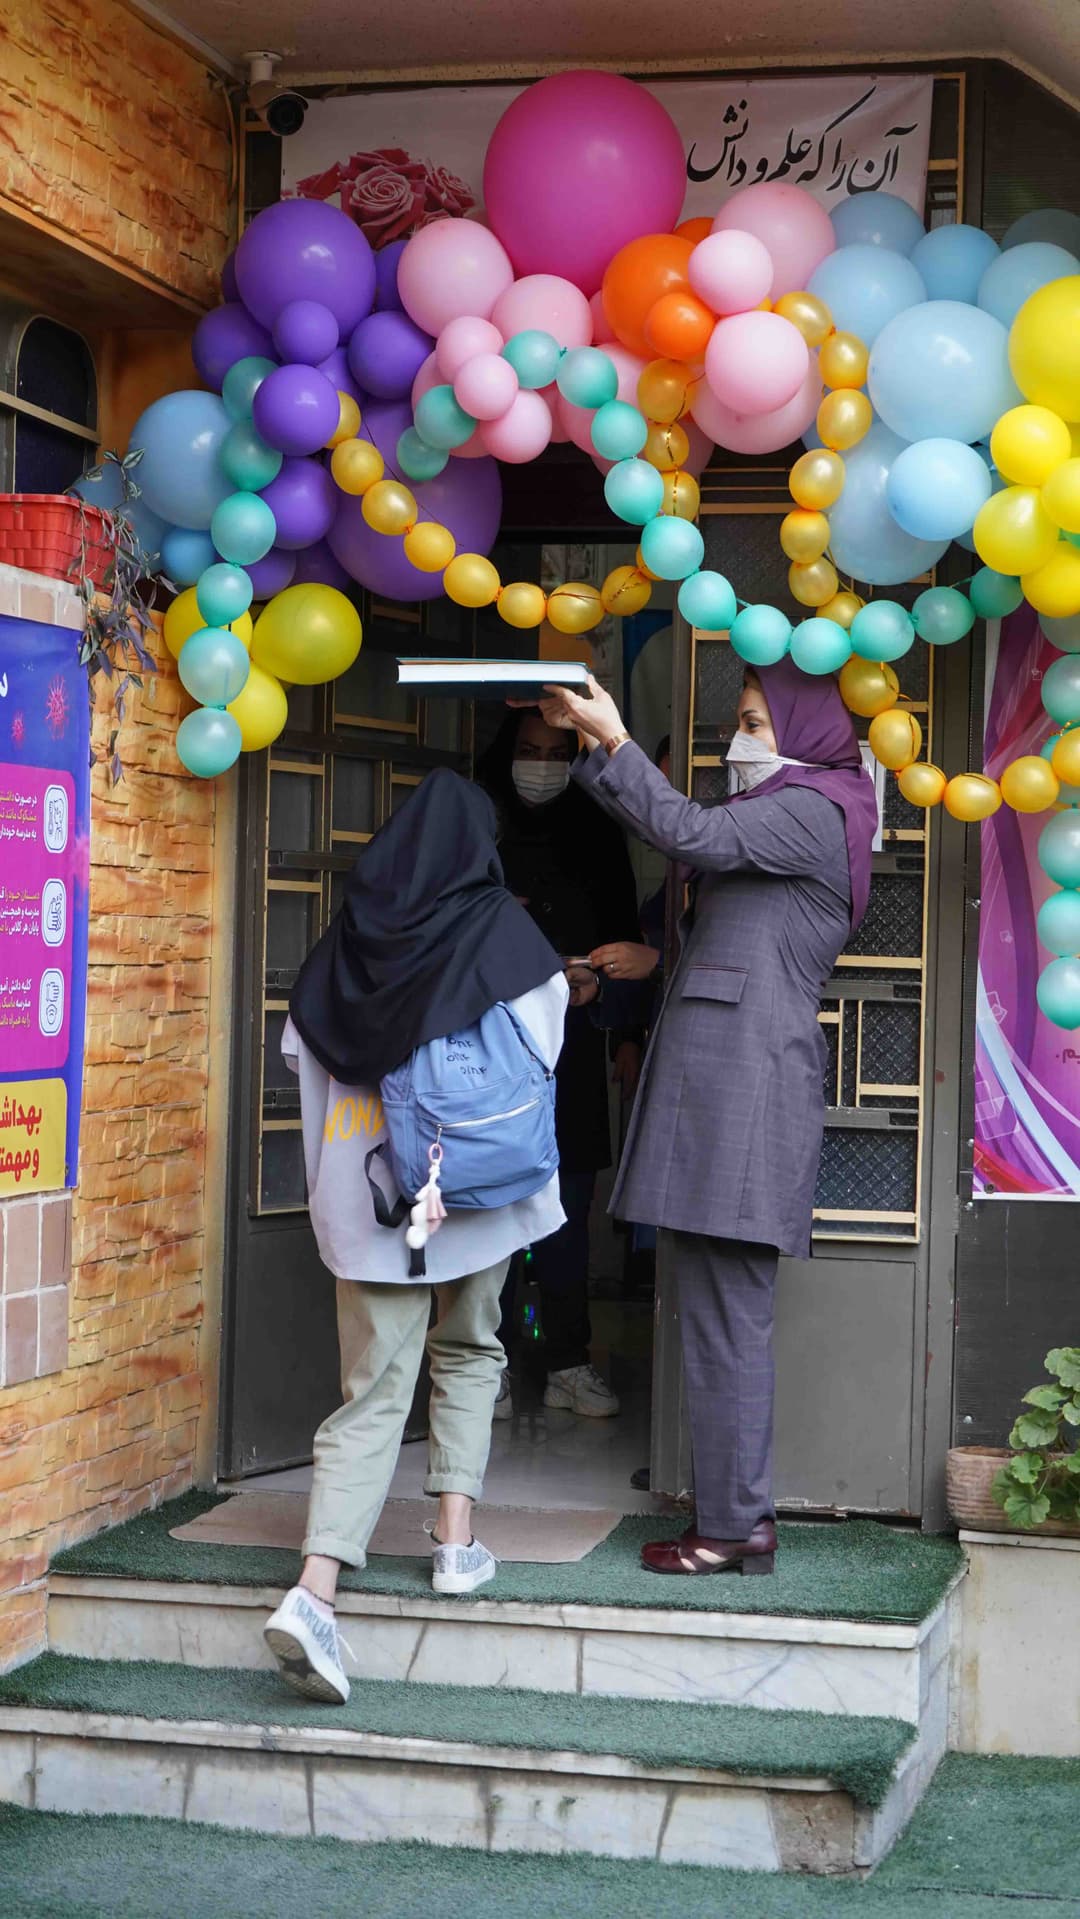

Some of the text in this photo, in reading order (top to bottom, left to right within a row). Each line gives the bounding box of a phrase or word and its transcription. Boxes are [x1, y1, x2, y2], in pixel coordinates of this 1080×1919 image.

[686, 85, 918, 195] آن را که علم و دانش
[16, 828, 31, 841] مدرسه
[24, 906, 40, 920] مدرسه
[9, 920, 22, 936] کلاس
[9, 978, 21, 994] دانش
[21, 978, 32, 994] کلیه
[16, 999, 31, 1011] مدرسه
